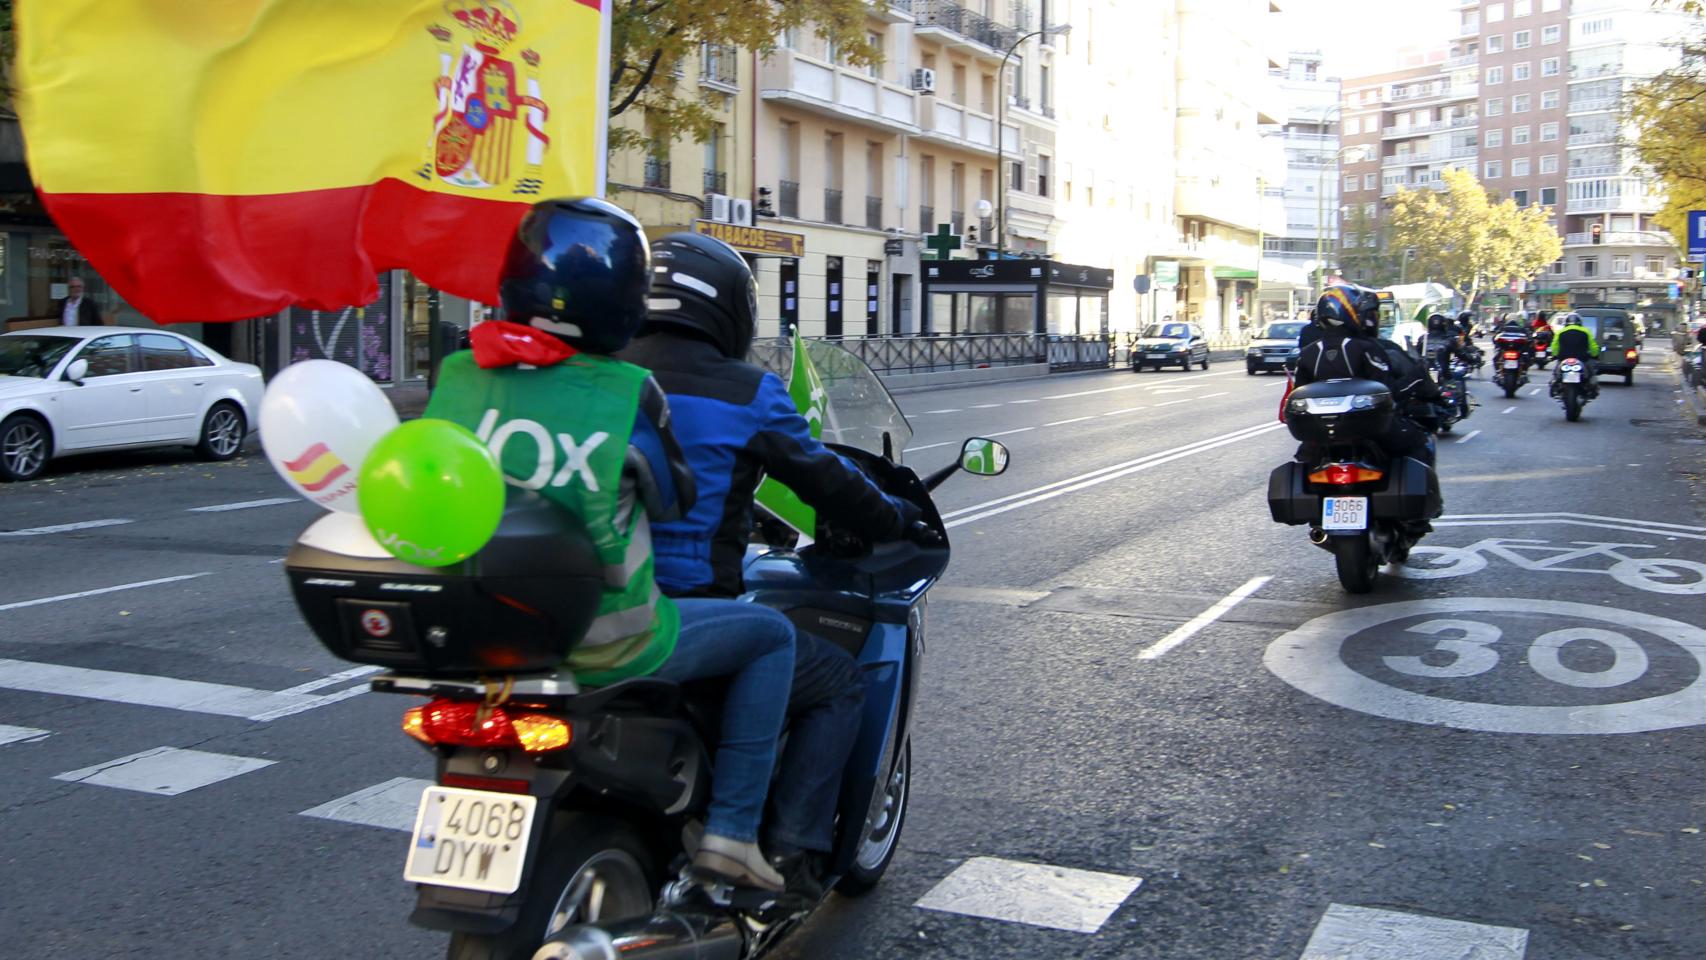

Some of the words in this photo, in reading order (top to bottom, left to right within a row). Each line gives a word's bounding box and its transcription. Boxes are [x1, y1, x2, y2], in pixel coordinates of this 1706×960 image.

[709, 224, 765, 247] TABACOS
[1382, 618, 1648, 688] 30
[446, 799, 526, 841] 4068
[434, 838, 497, 880] DYW
